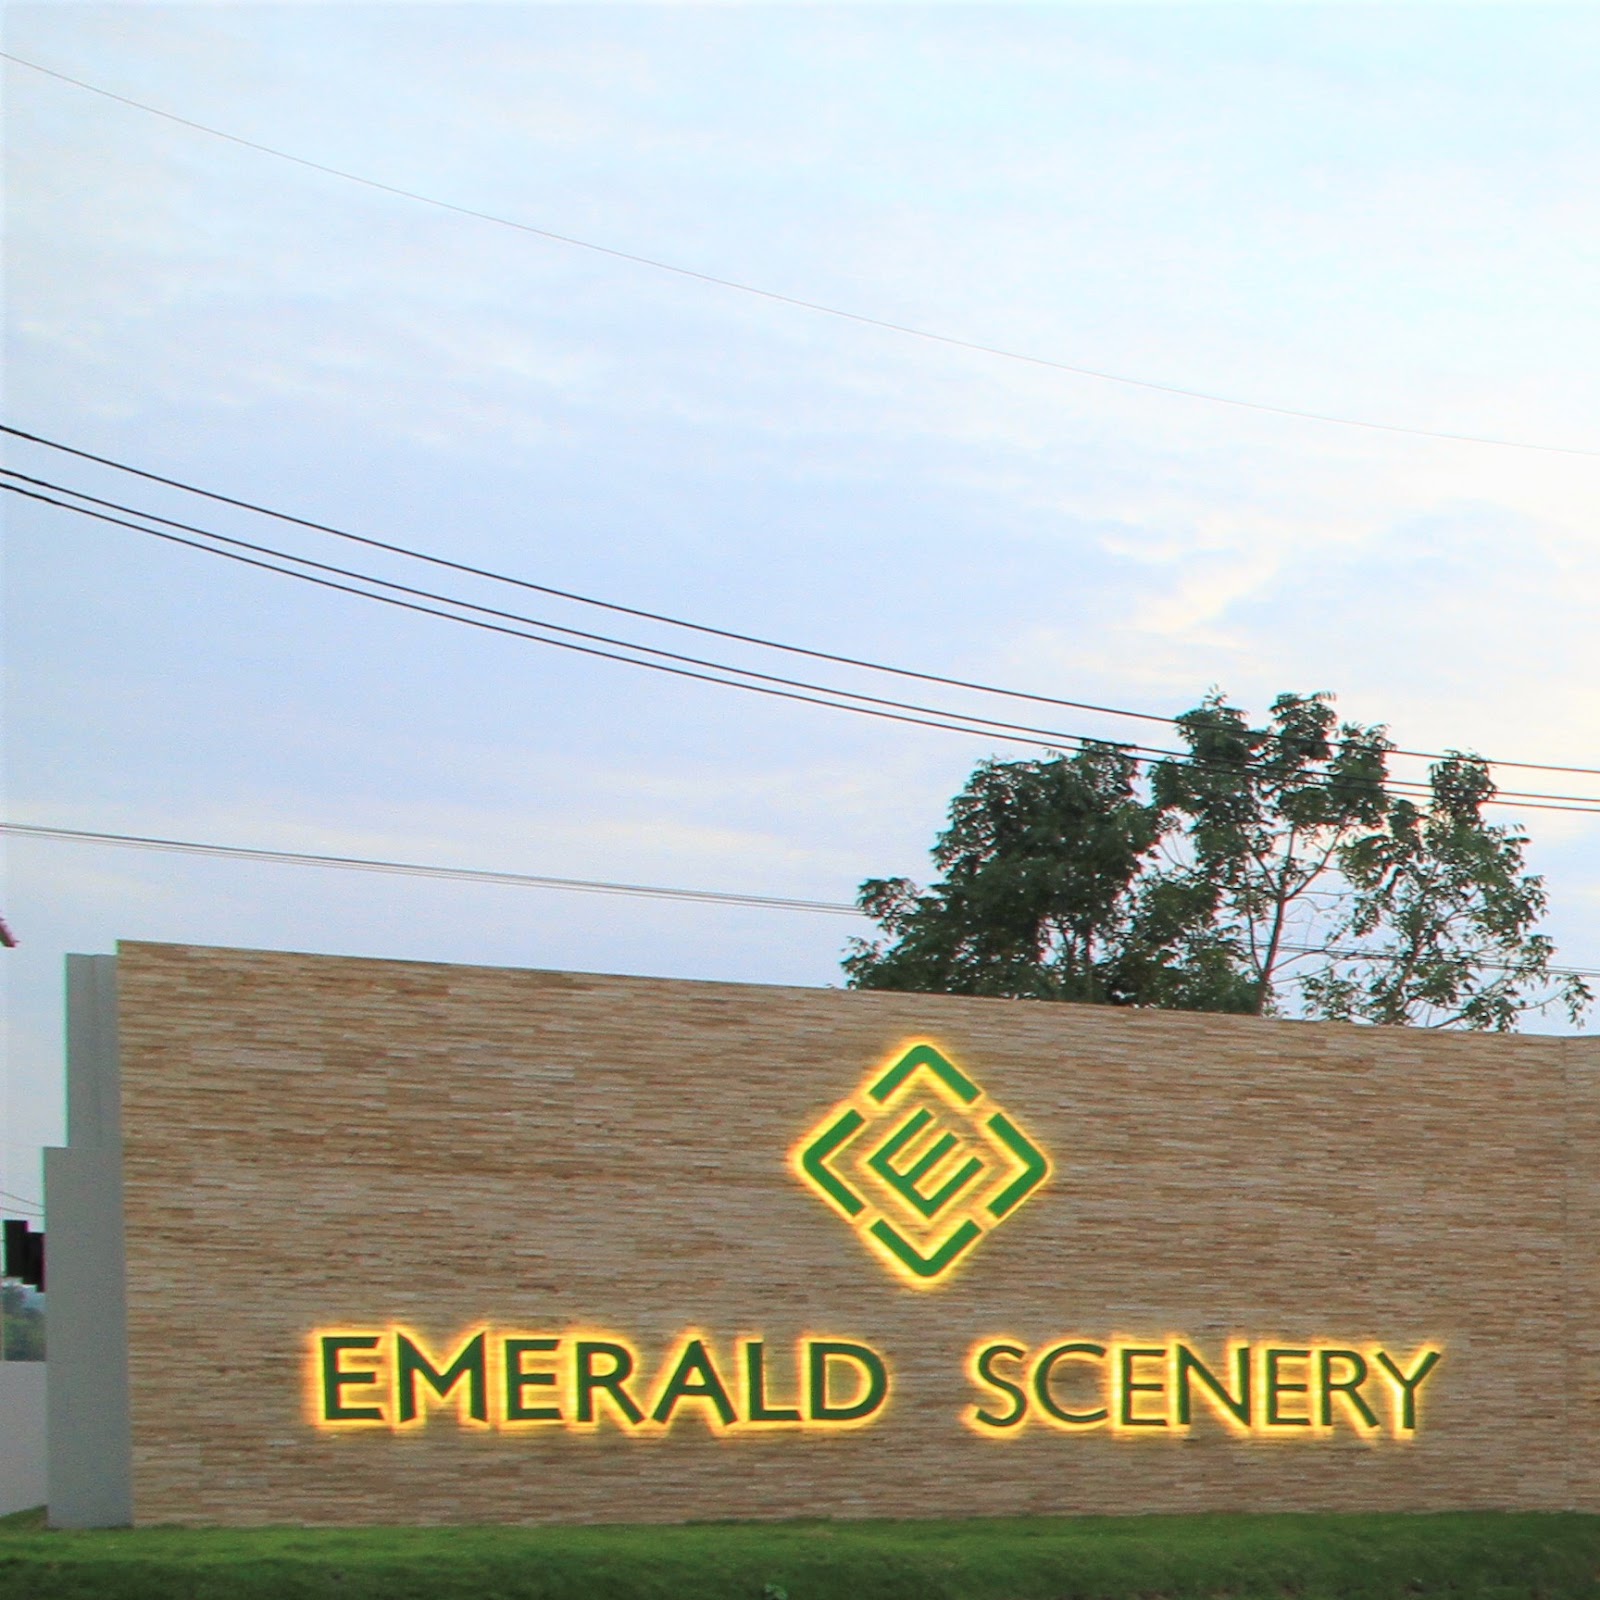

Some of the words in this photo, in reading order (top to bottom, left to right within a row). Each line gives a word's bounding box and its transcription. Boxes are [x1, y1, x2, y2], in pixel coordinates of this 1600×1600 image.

[867, 1108, 983, 1217] E
[319, 1330, 887, 1426] EMERALD
[974, 1343, 1440, 1430] SCENERY
